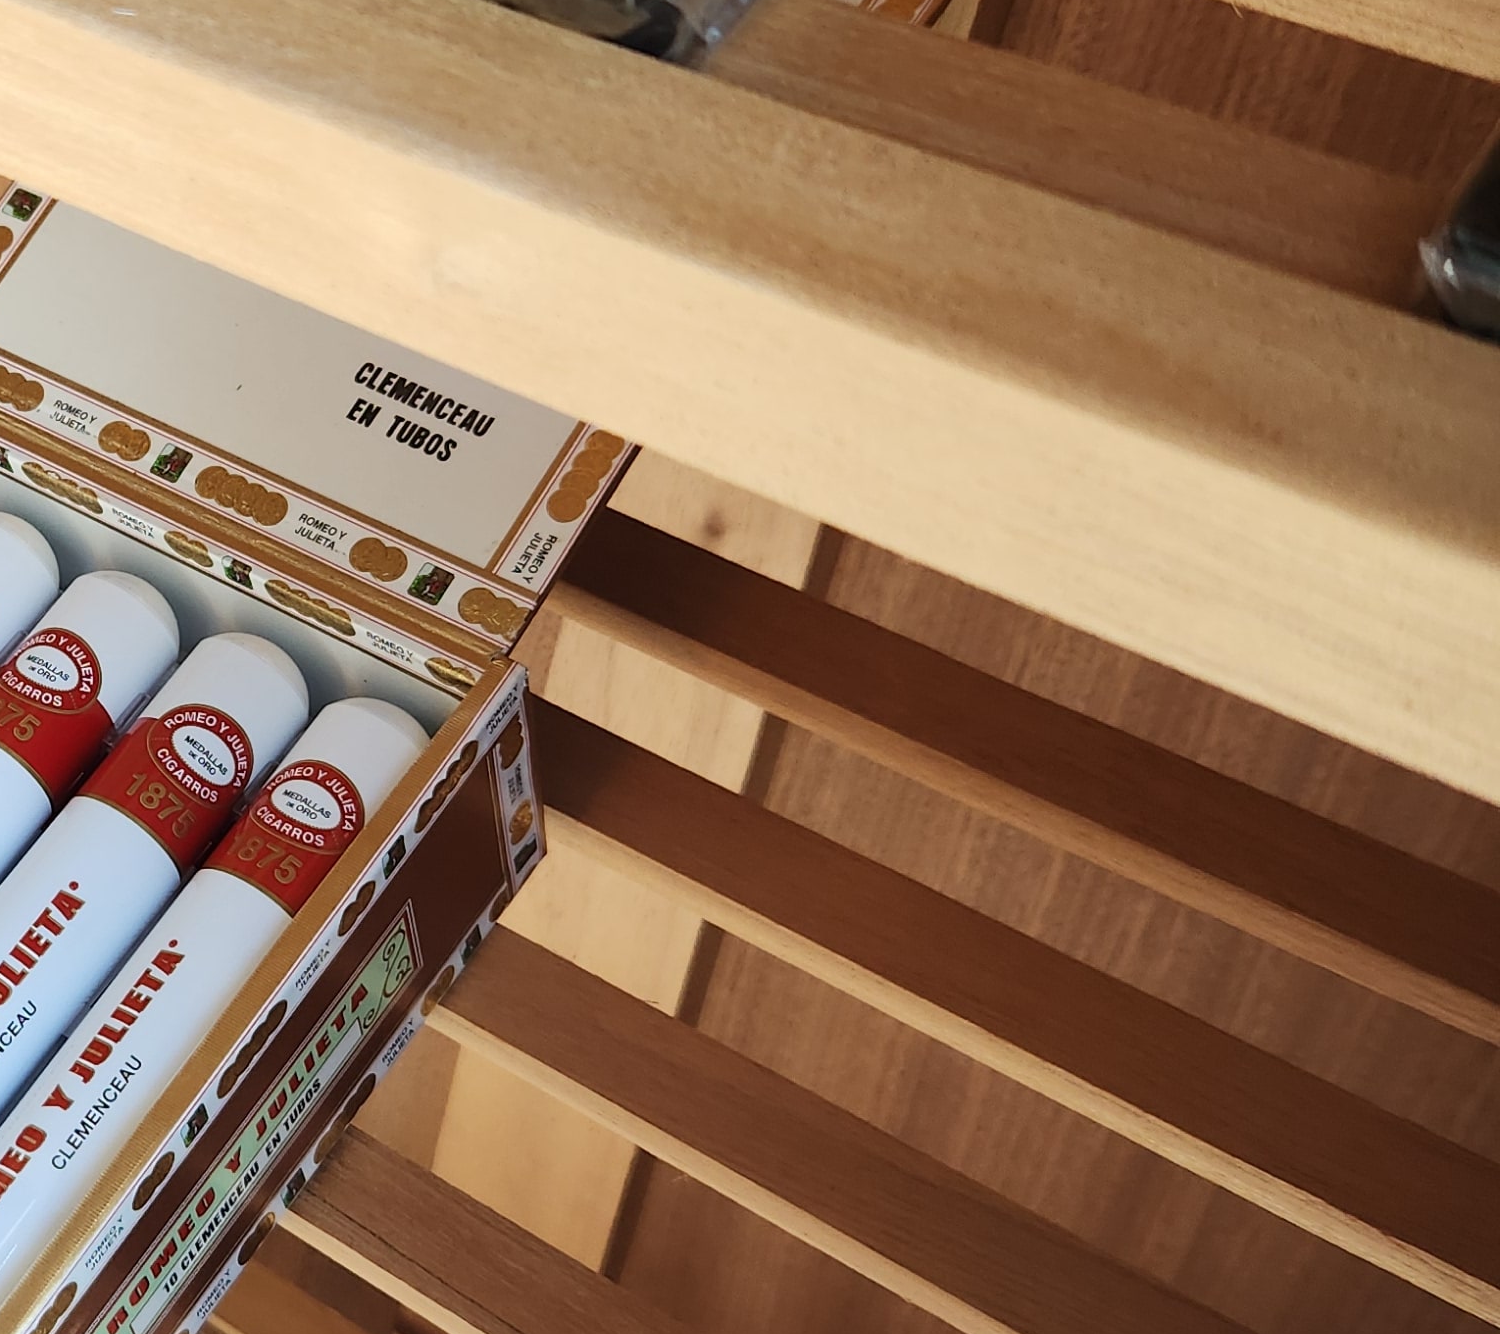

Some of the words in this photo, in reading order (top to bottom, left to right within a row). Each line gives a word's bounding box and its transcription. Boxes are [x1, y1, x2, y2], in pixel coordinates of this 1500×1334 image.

[52, 399, 86, 421] ROMEO
[354, 362, 496, 437] CLEMENCEAU
[49, 410, 88, 434] JULIETA
[345, 397, 382, 428] EN
[385, 414, 458, 462] TUBOS
[293, 525, 336, 552] JULIETA
[298, 512, 336, 536] ROMEO
[510, 531, 541, 575] JULIETA
[531, 533, 558, 574] ROMEO
[2, 670, 63, 708] CIGARROS
[26, 653, 70, 682] MEDALLAS
[36, 666, 57, 683] ORO
[65, 643, 95, 694] JULIETA
[163, 711, 217, 730] ROMEO
[219, 721, 229, 733] Y
[226, 731, 248, 788] JULIETA
[183, 734, 229, 777] MEDALLAS
[197, 755, 217, 777] ORO
[156, 747, 219, 804] CIGARROS
[124, 771, 197, 839] 1875
[282, 787, 332, 819] MEDALLAS
[295, 802, 318, 820] ORO
[315, 769, 327, 780] Y
[325, 777, 357, 833] JULIETA
[255, 805, 325, 848] CIGARROS
[226, 830, 304, 885] 1875
[41, 1083, 75, 1111] Y
[68, 948, 186, 1085] JULIETA
[223, 1146, 243, 1175] Y
[253, 983, 368, 1142] JULIETA
[50, 1054, 143, 1171] CLEMENCEAU
[162, 1272, 179, 1295] 10
[180, 1162, 260, 1273] CLEMENCEAU
[264, 1132, 281, 1158] EN
[281, 1078, 321, 1131] TUBOS
